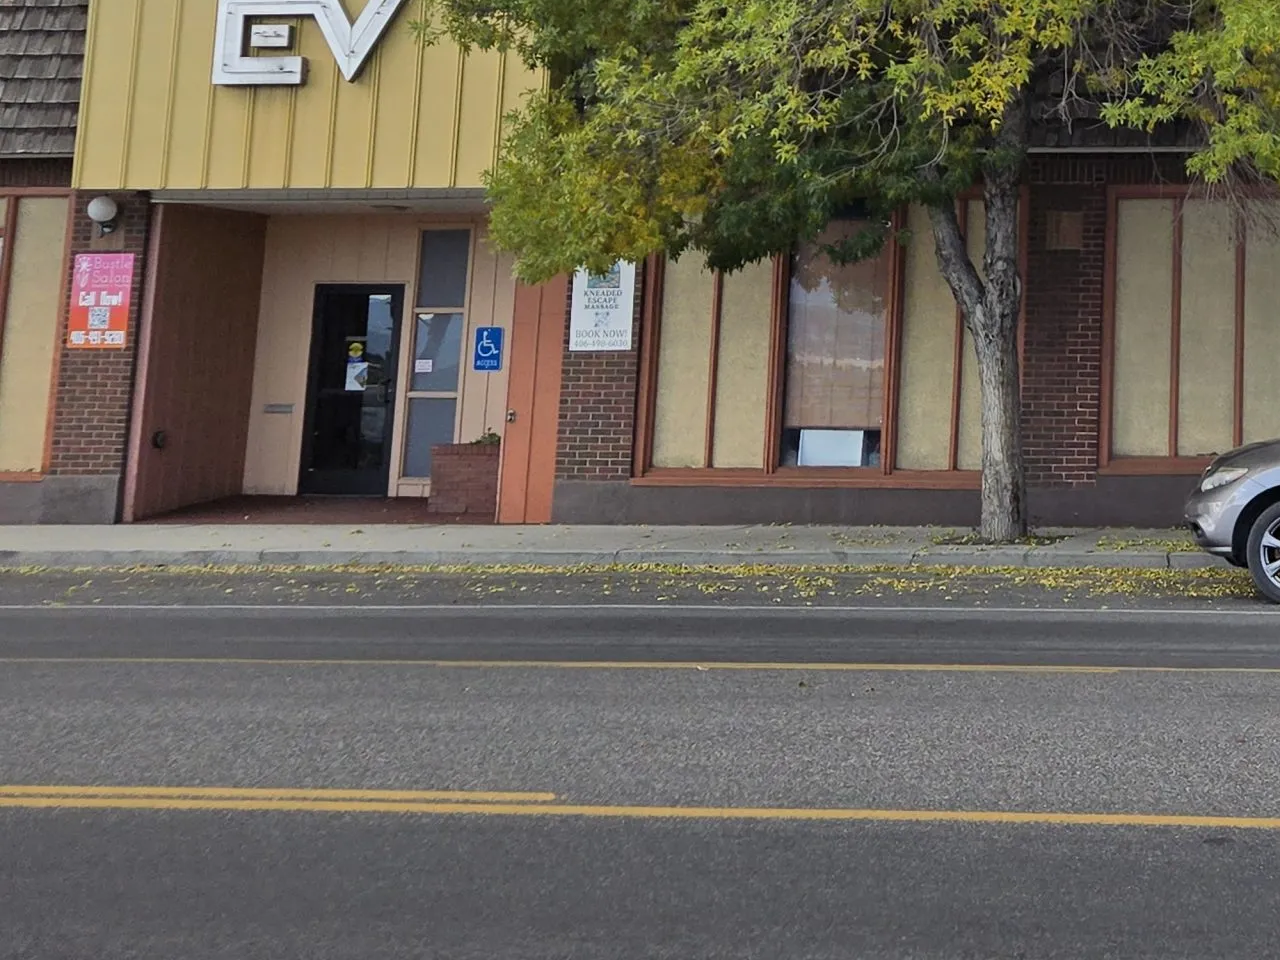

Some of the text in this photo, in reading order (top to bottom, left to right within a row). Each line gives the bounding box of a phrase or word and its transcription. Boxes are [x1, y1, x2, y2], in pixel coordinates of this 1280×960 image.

[92, 270, 130, 283] Salon
[79, 291, 97, 306] Call
[583, 289, 622, 297] KNEADED
[575, 329, 628, 338] BOOK NOW!
